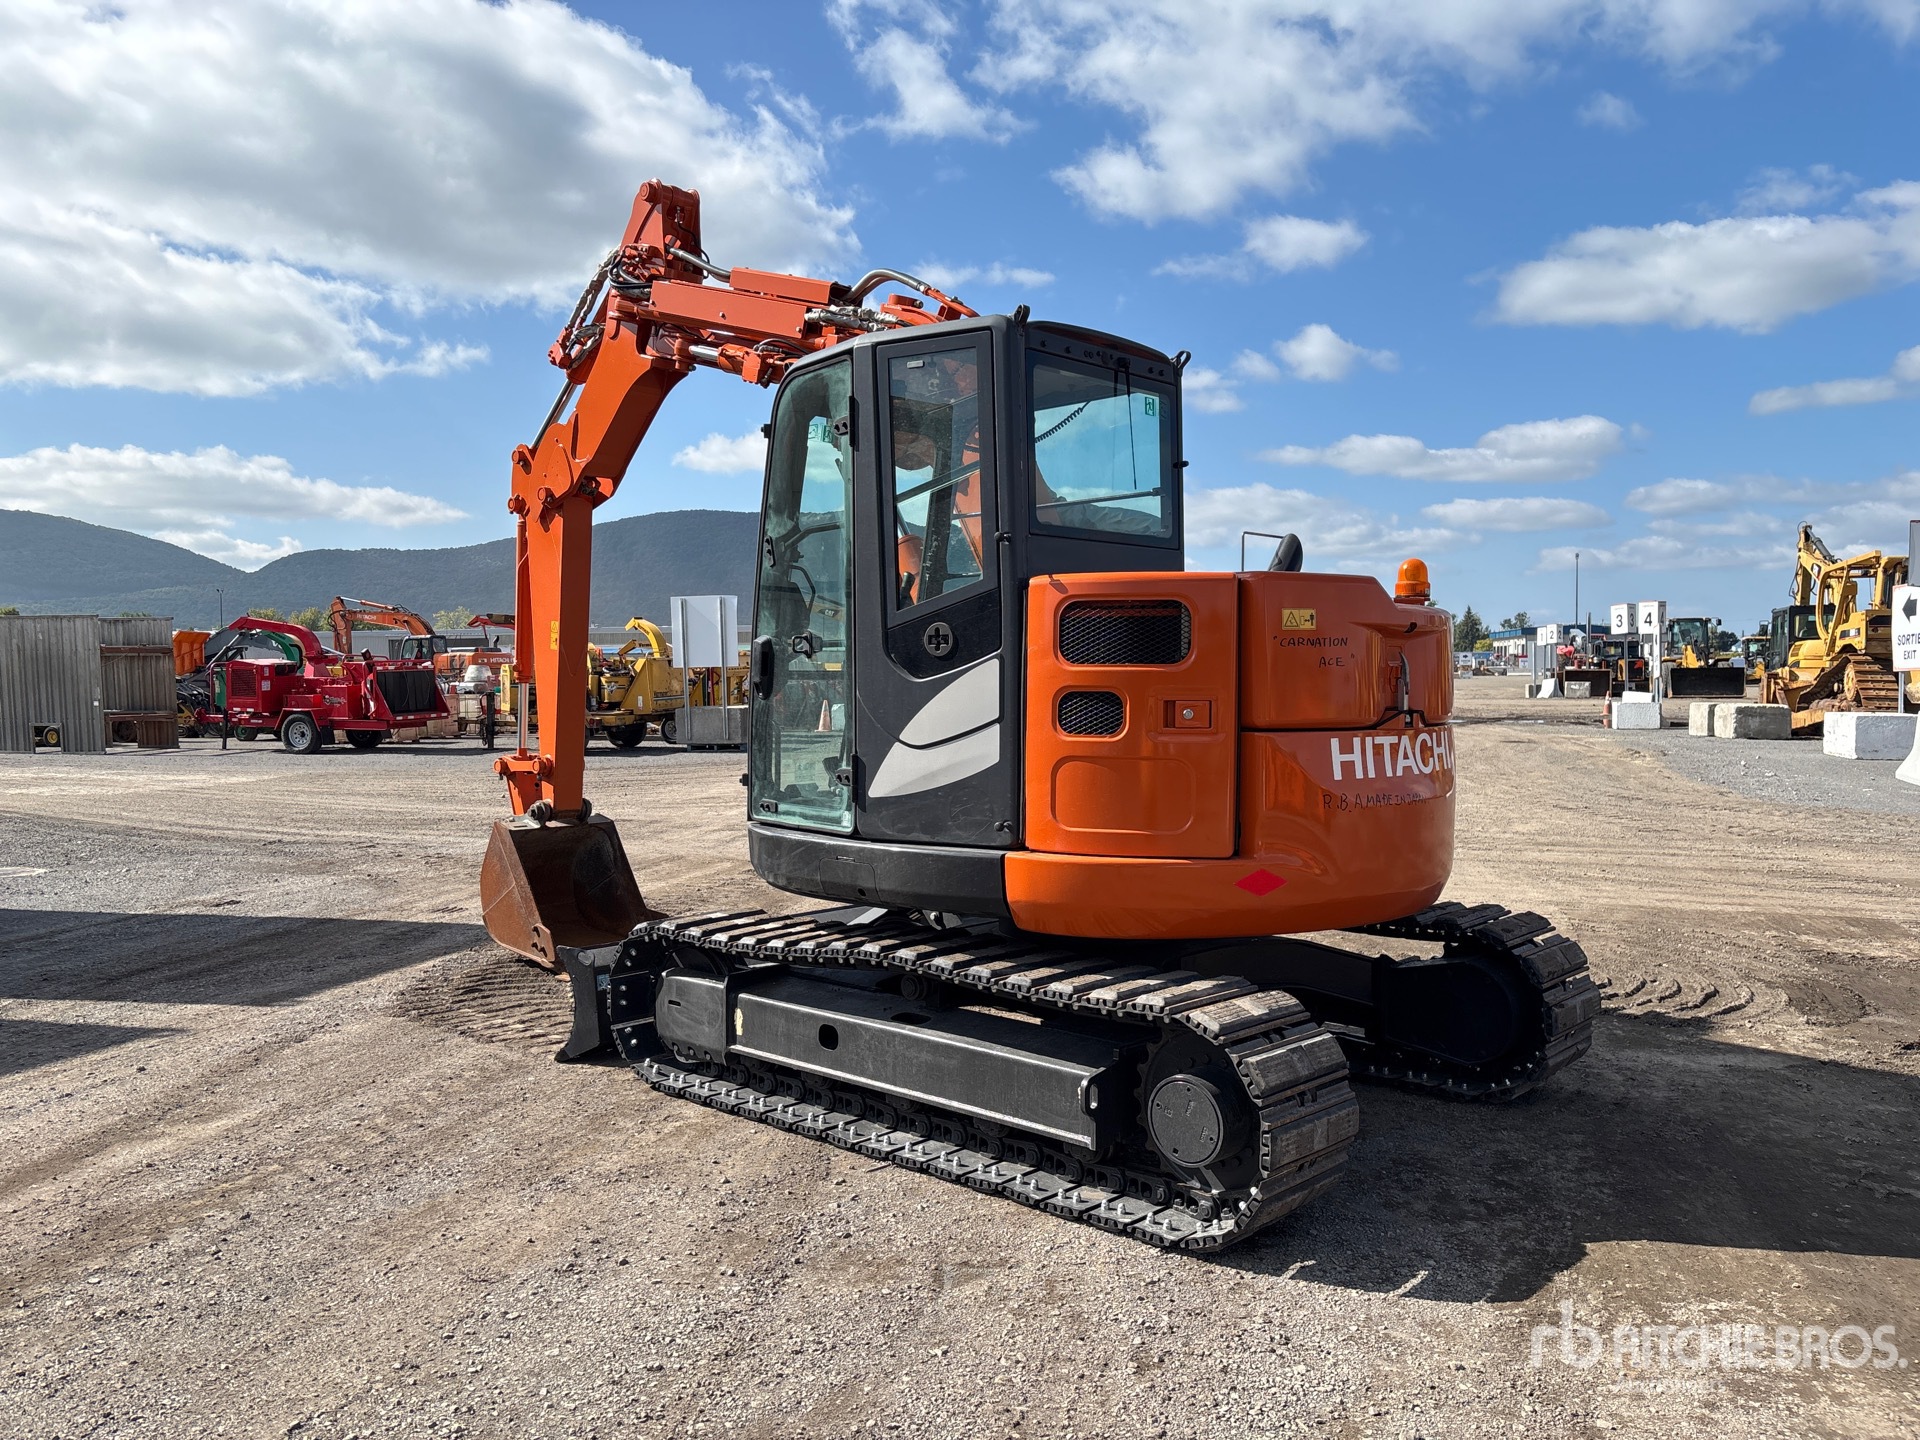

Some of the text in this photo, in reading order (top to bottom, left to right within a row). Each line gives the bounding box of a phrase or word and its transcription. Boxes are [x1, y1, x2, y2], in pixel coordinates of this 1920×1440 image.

[1616, 614, 1623, 628] 3
[1629, 613, 1635, 627] 3
[1644, 612, 1653, 627] 4
[1549, 630, 1555, 640] 2
[1897, 633, 1920, 646] SORTIE
[1903, 650, 1917, 660] EXIT
[1330, 731, 1452, 780] HITACHI
